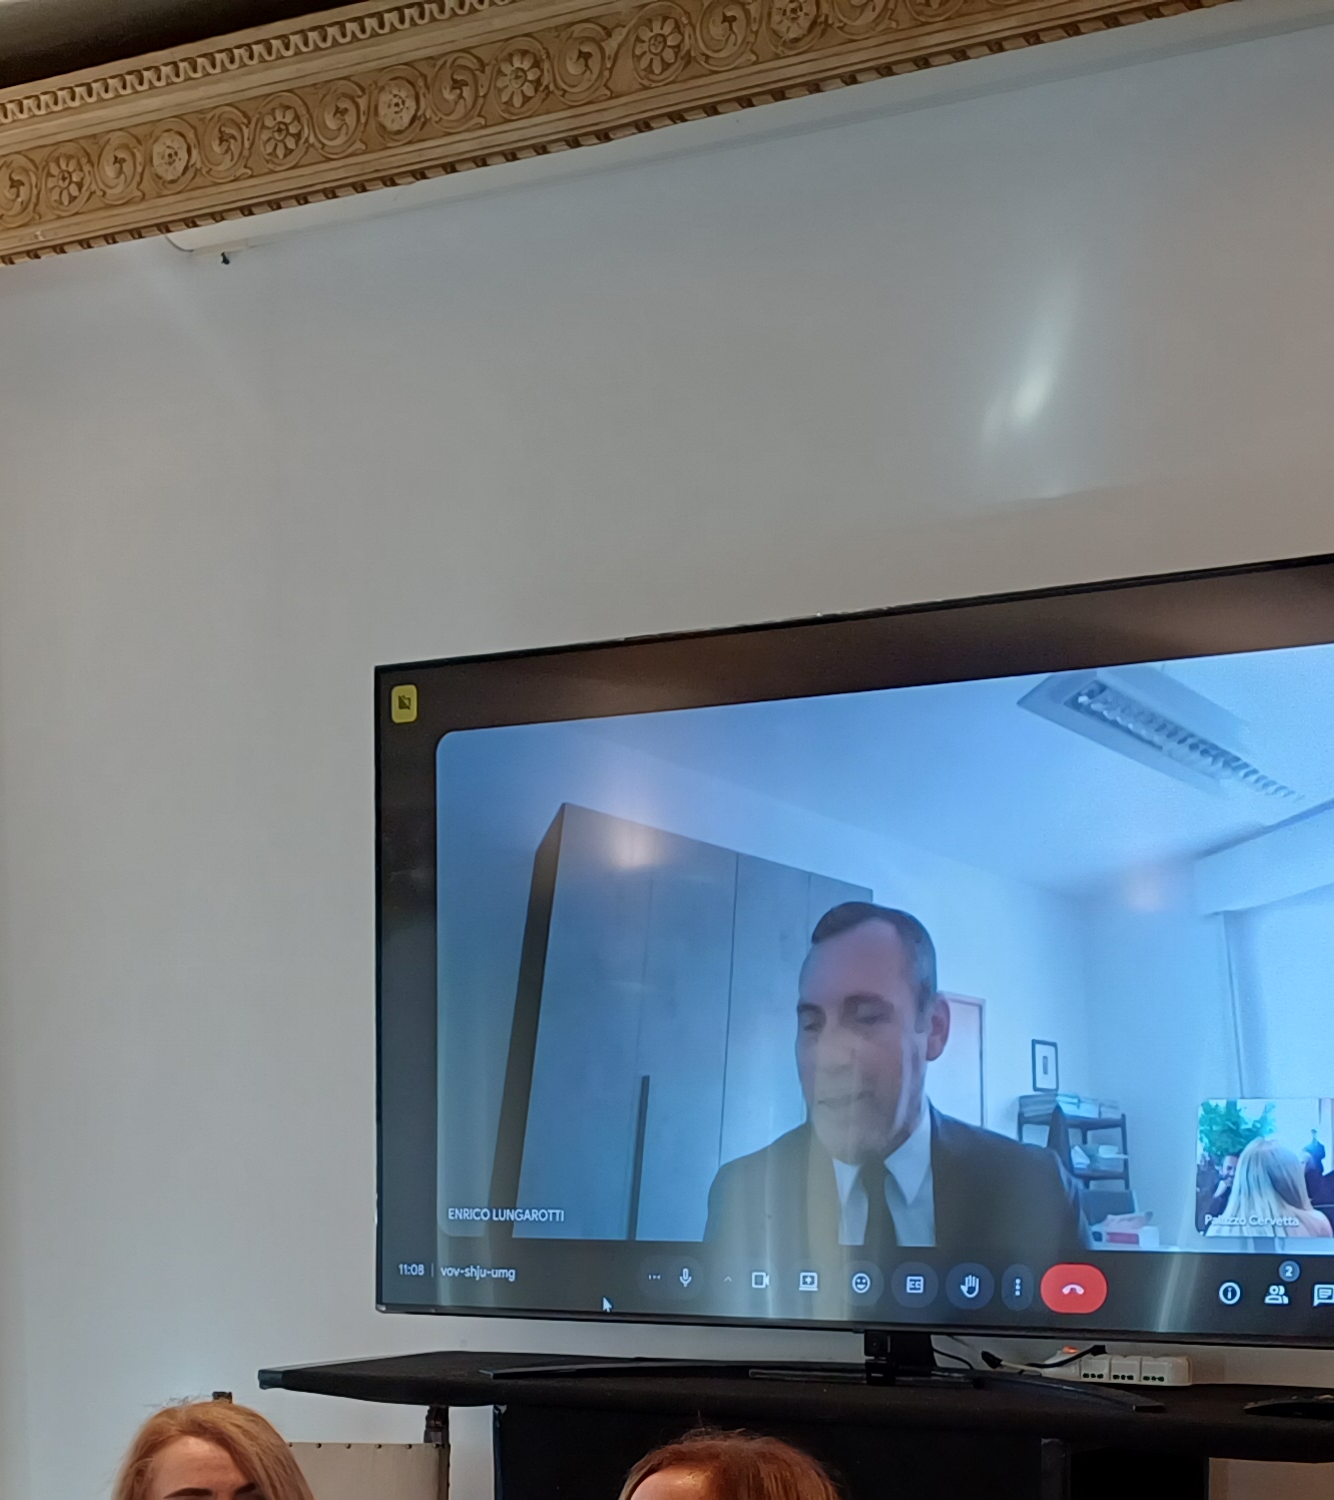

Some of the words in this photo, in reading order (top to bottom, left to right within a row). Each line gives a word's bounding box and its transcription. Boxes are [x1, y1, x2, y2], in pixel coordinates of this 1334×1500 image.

[448, 1208, 490, 1220] ENRICO
[492, 1208, 565, 1222] LUNGAROTTI
[1249, 1215, 1300, 1226] Cervetta
[398, 1263, 425, 1276] 11:08
[440, 1265, 516, 1282] vov-shju-umg
[1285, 1266, 1293, 1277] 2
